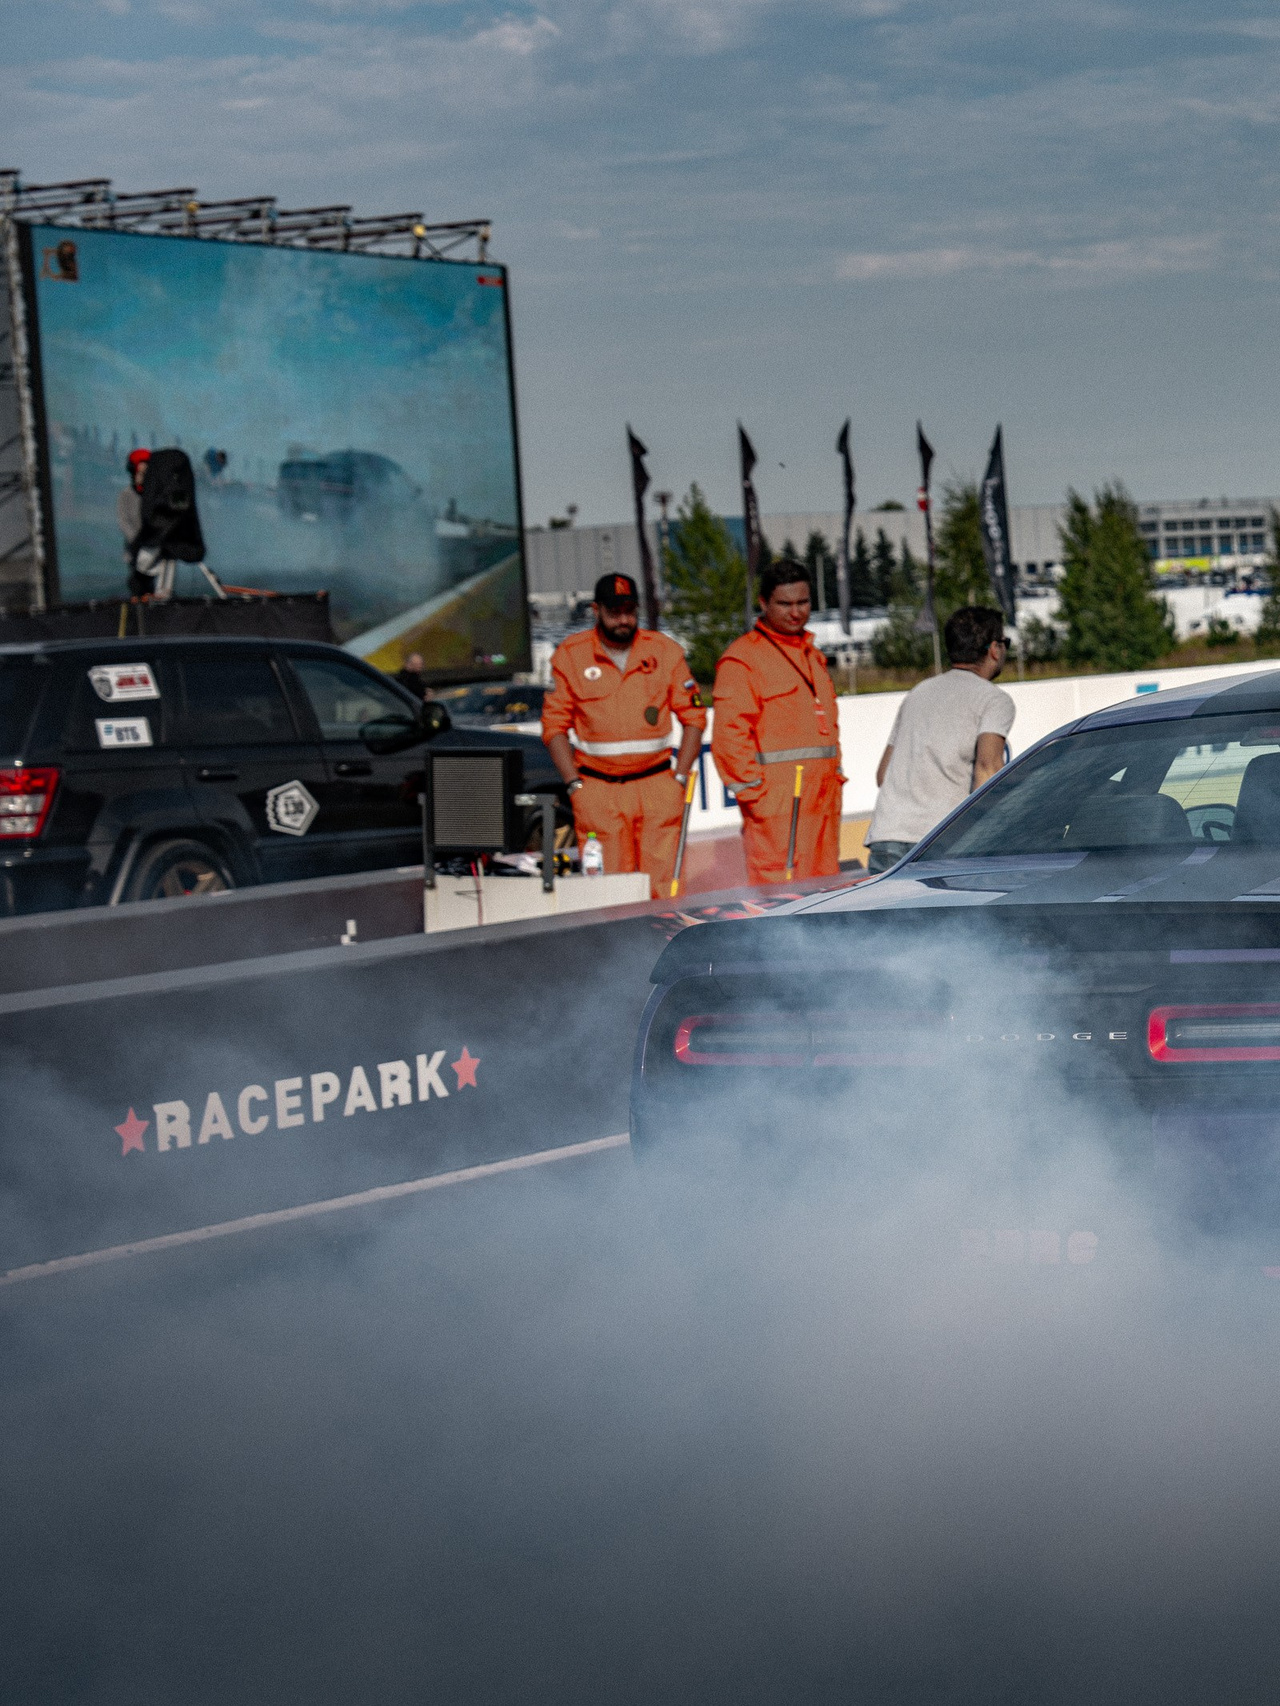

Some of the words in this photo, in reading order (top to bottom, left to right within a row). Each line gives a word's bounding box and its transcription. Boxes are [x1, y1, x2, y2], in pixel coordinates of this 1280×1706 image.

[115, 726, 141, 742] ВТБ
[966, 1031, 1127, 1042] DODGE
[153, 1050, 450, 1152] RACEPARK
